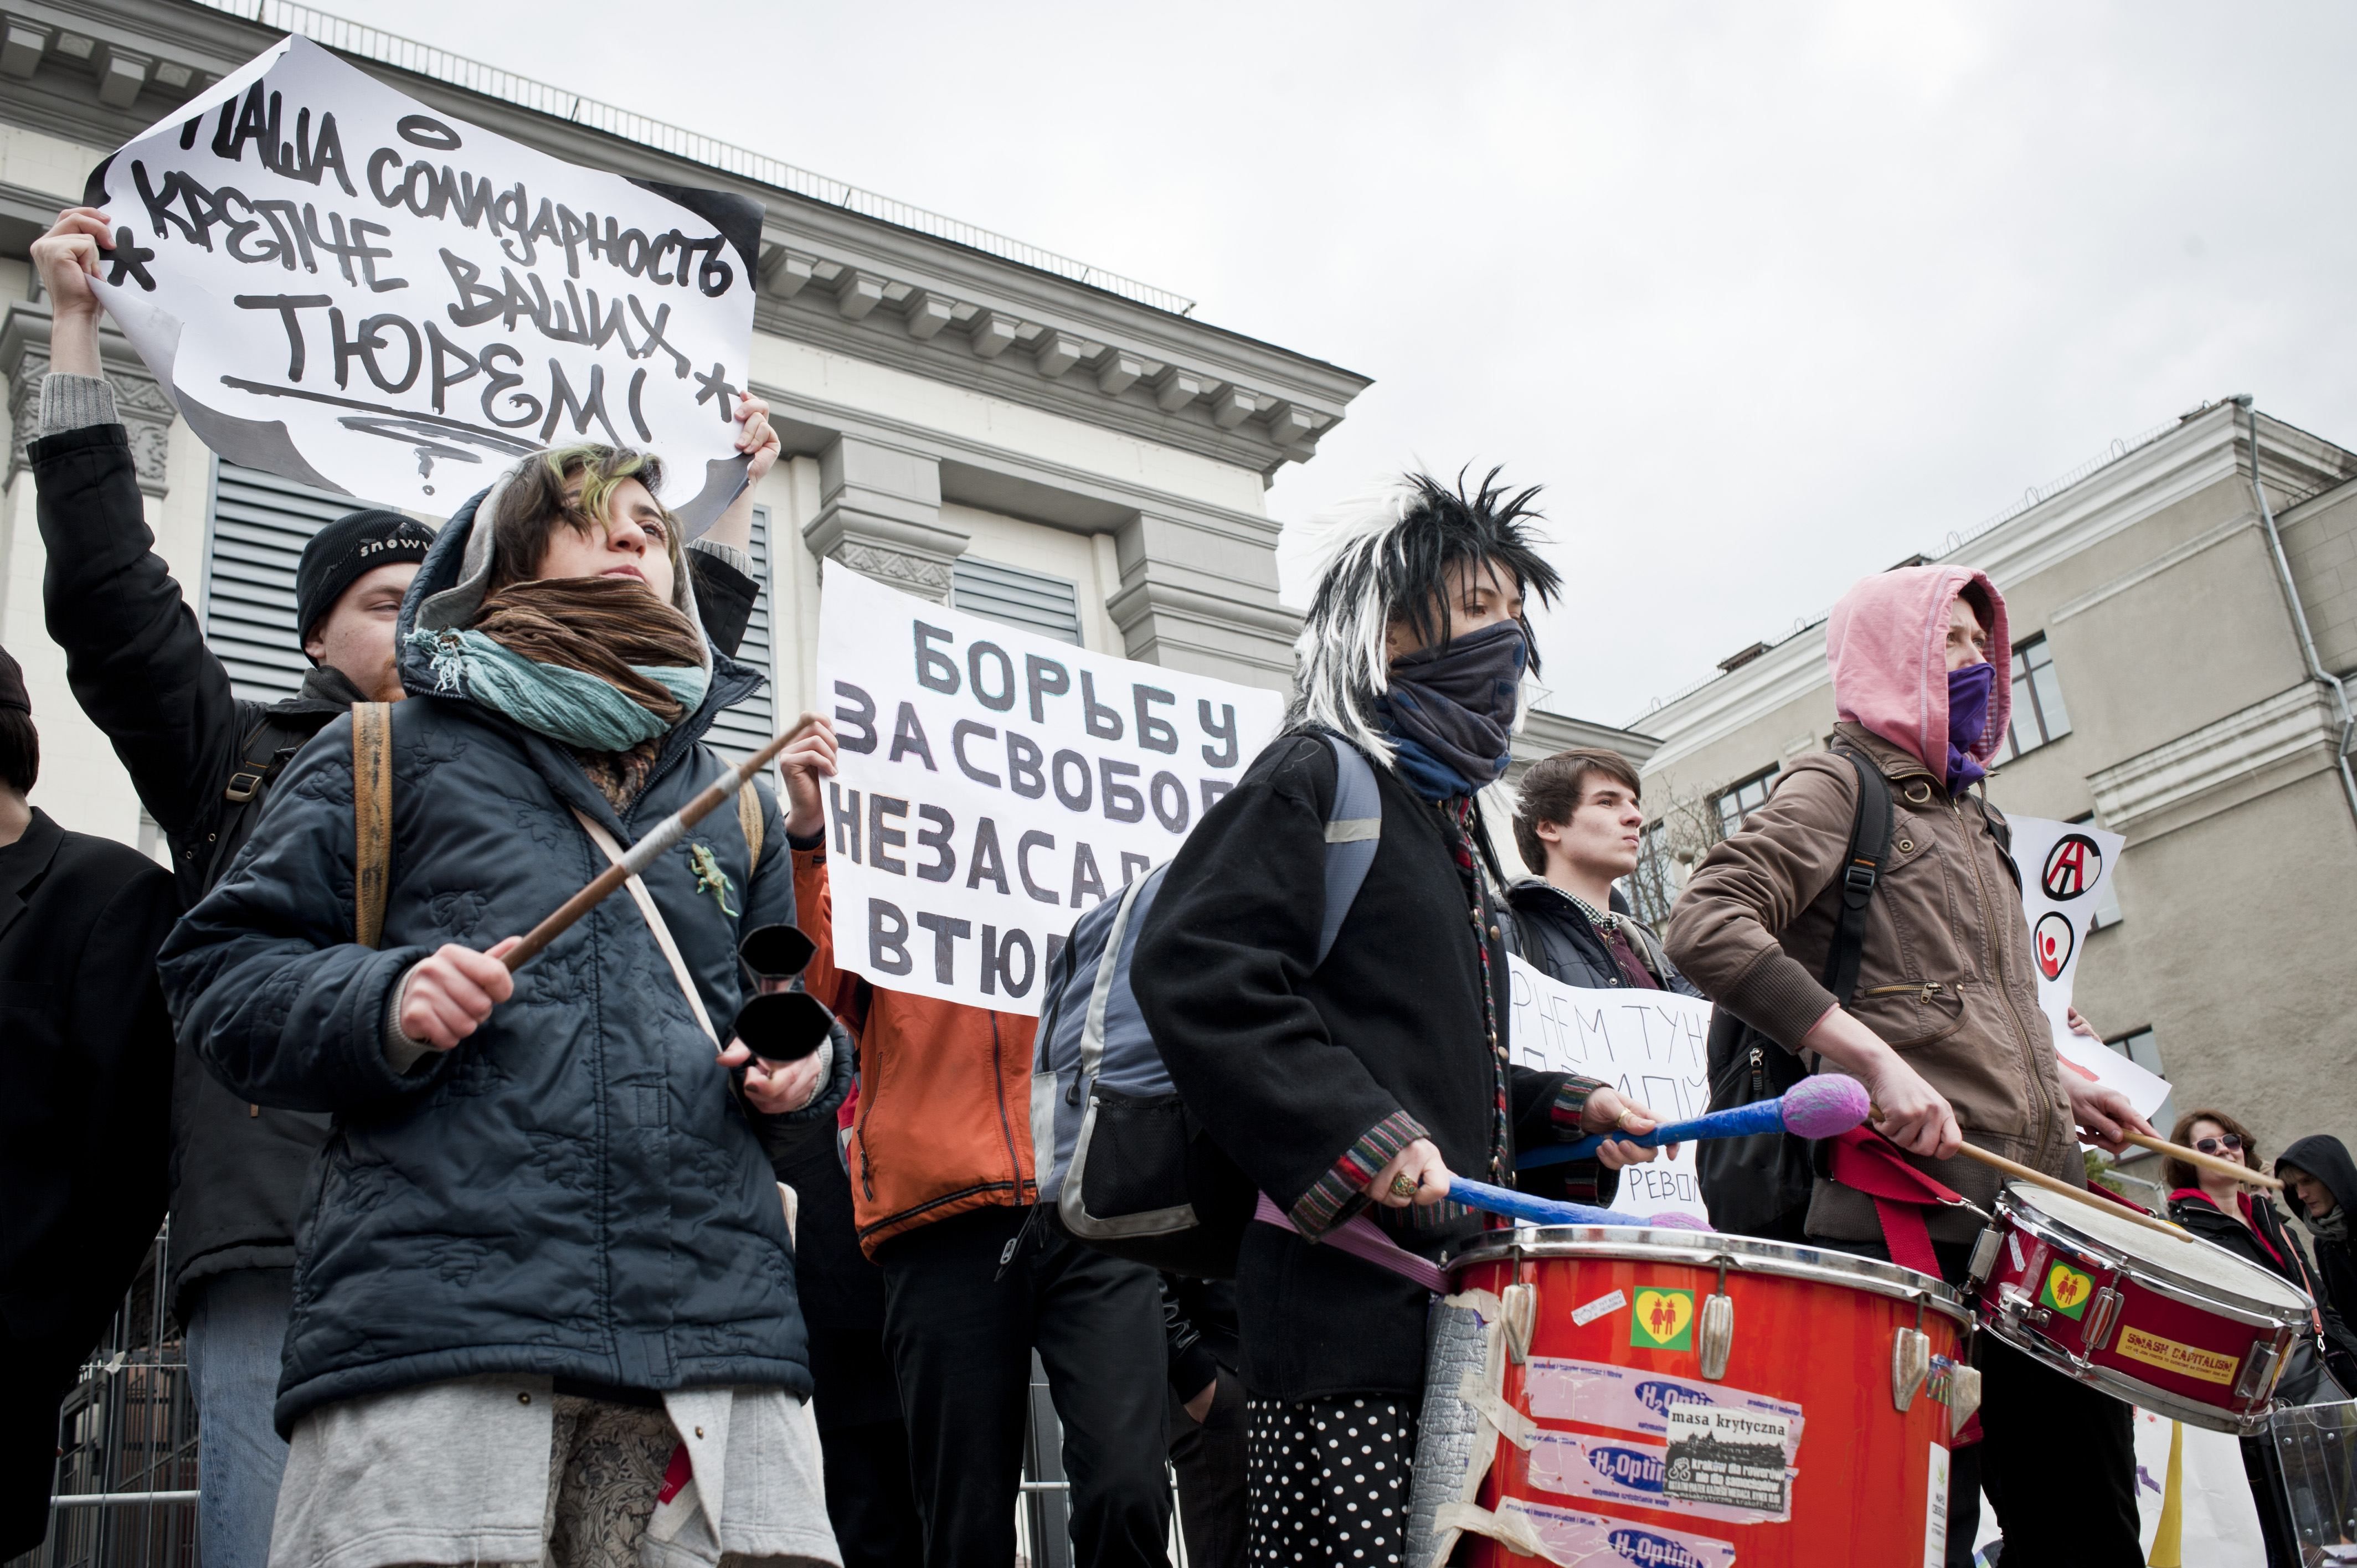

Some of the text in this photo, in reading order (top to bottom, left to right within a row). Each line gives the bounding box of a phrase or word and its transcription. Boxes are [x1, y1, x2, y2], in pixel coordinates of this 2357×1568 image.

[131, 159, 691, 379] КРЕПЧЕ ВАШИХ
[912, 618, 1239, 769] БОРЬБУ
[1621, 1005, 1711, 1068] ТУН
[2127, 1333, 2234, 1372] SMASH CAPITALISM
[1672, 1411, 1785, 1436] masa krytyczna
